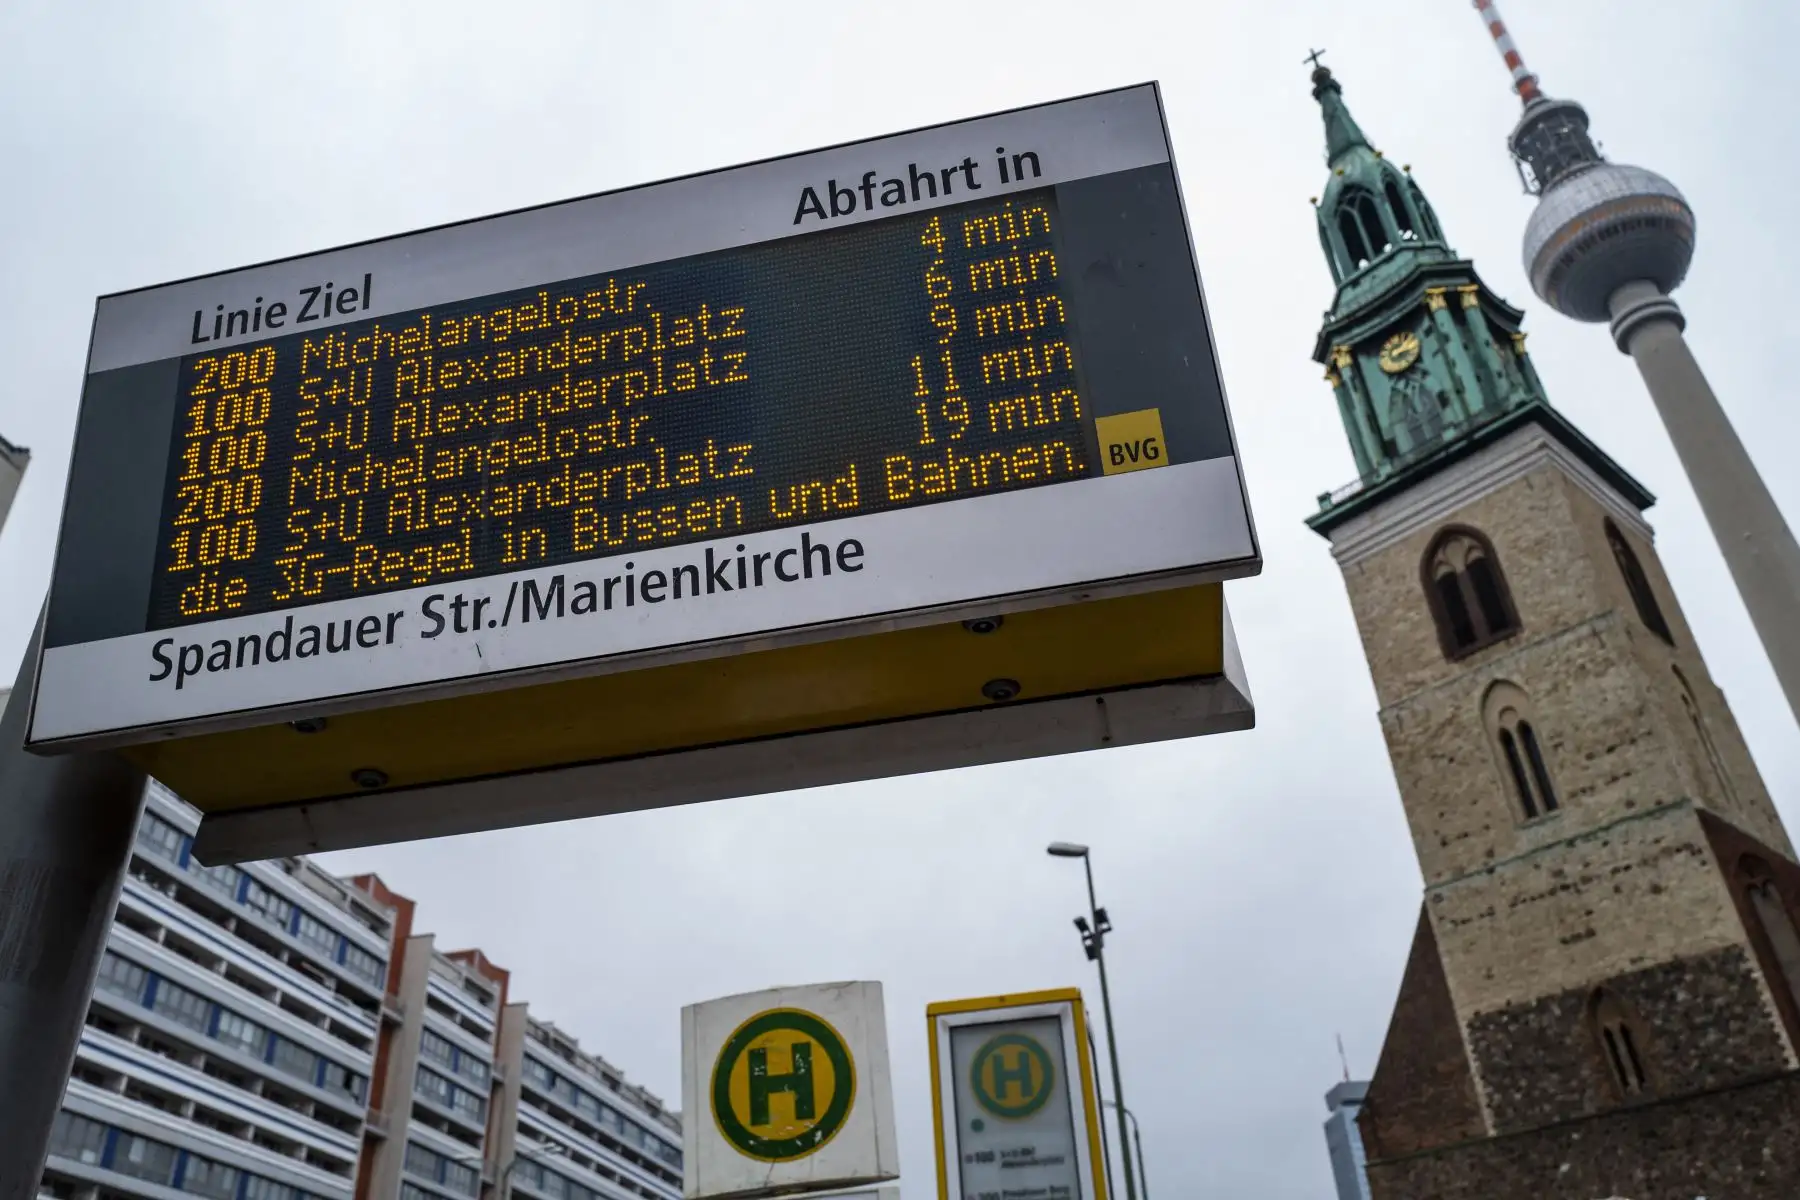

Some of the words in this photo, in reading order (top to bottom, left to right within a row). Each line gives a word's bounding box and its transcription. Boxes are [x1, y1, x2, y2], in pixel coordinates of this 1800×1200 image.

[793, 155, 981, 225] Abfahrt
[997, 146, 1042, 184] in
[185, 388, 271, 438] 100
[299, 367, 372, 413] S+U
[396, 303, 746, 398] Alexanderplatz
[926, 260, 951, 298] 6
[969, 246, 1057, 292] min
[190, 346, 276, 396] 200
[302, 278, 650, 373] Michelangelostr.
[921, 216, 946, 254] 4
[963, 202, 1050, 249] min
[191, 296, 287, 344] Linie
[296, 273, 372, 324] Ziel
[174, 475, 262, 527] 200
[289, 411, 655, 506] Michelangelostr.
[911, 350, 960, 396] 11
[982, 336, 1073, 384] min
[179, 431, 266, 481] 100
[293, 410, 370, 459] S+U
[393, 348, 748, 443] Alexanderplatz
[930, 306, 957, 345] 9
[975, 290, 1065, 338] min
[1108, 437, 1160, 467] BVG
[168, 517, 257, 571] 100
[285, 500, 363, 551] S+U
[388, 438, 753, 535] Alexanderplatz
[916, 396, 969, 445] 19
[988, 383, 1080, 433] min
[180, 573, 247, 616] die
[272, 528, 475, 600] 3G-Regel
[502, 521, 547, 563] in
[573, 495, 742, 552] Bussen
[769, 464, 858, 518] und
[886, 441, 1086, 501] Bahnen.
[149, 610, 405, 689] Spandauer
[421, 531, 865, 640] Str./Marienkirche
[748, 1041, 816, 1126] H
[992, 1051, 1034, 1099] H
